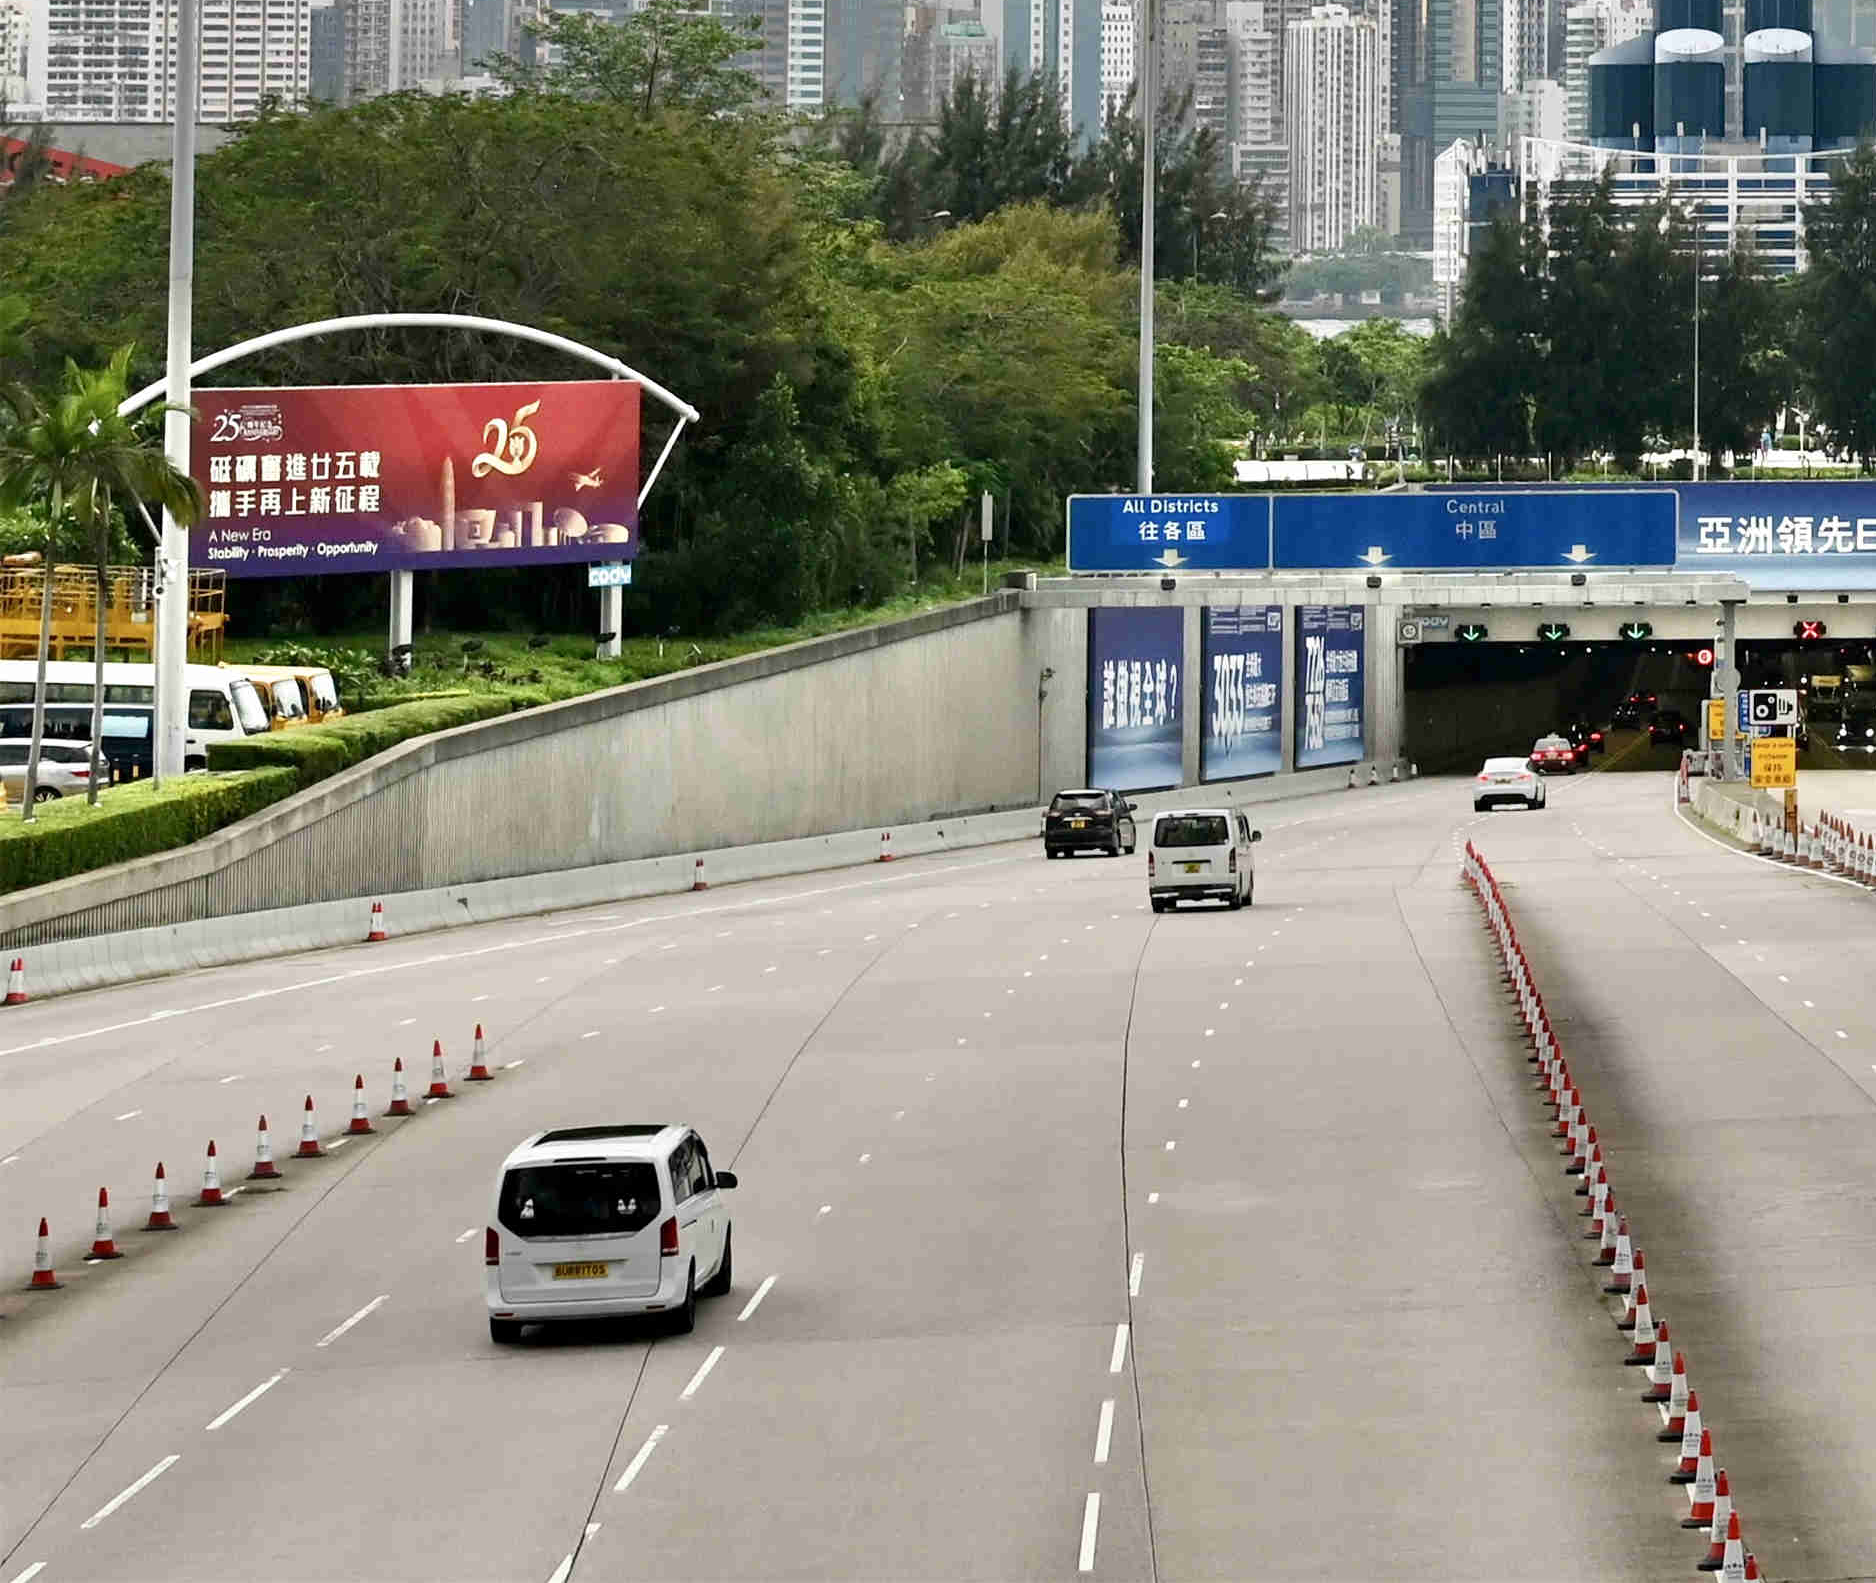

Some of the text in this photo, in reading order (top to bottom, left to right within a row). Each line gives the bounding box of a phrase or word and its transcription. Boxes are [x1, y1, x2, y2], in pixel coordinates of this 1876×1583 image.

[209, 451, 381, 483] 砥礪奮進廿五載
[209, 485, 381, 518] 攜手再上新征程
[1122, 499, 1219, 514] All Districts
[1446, 498, 1505, 515] Central
[209, 527, 272, 541] A New Era
[1139, 520, 1206, 541] 往各區
[1455, 520, 1497, 540] 中區
[208, 540, 379, 561] Stability Prosperity Opportunity
